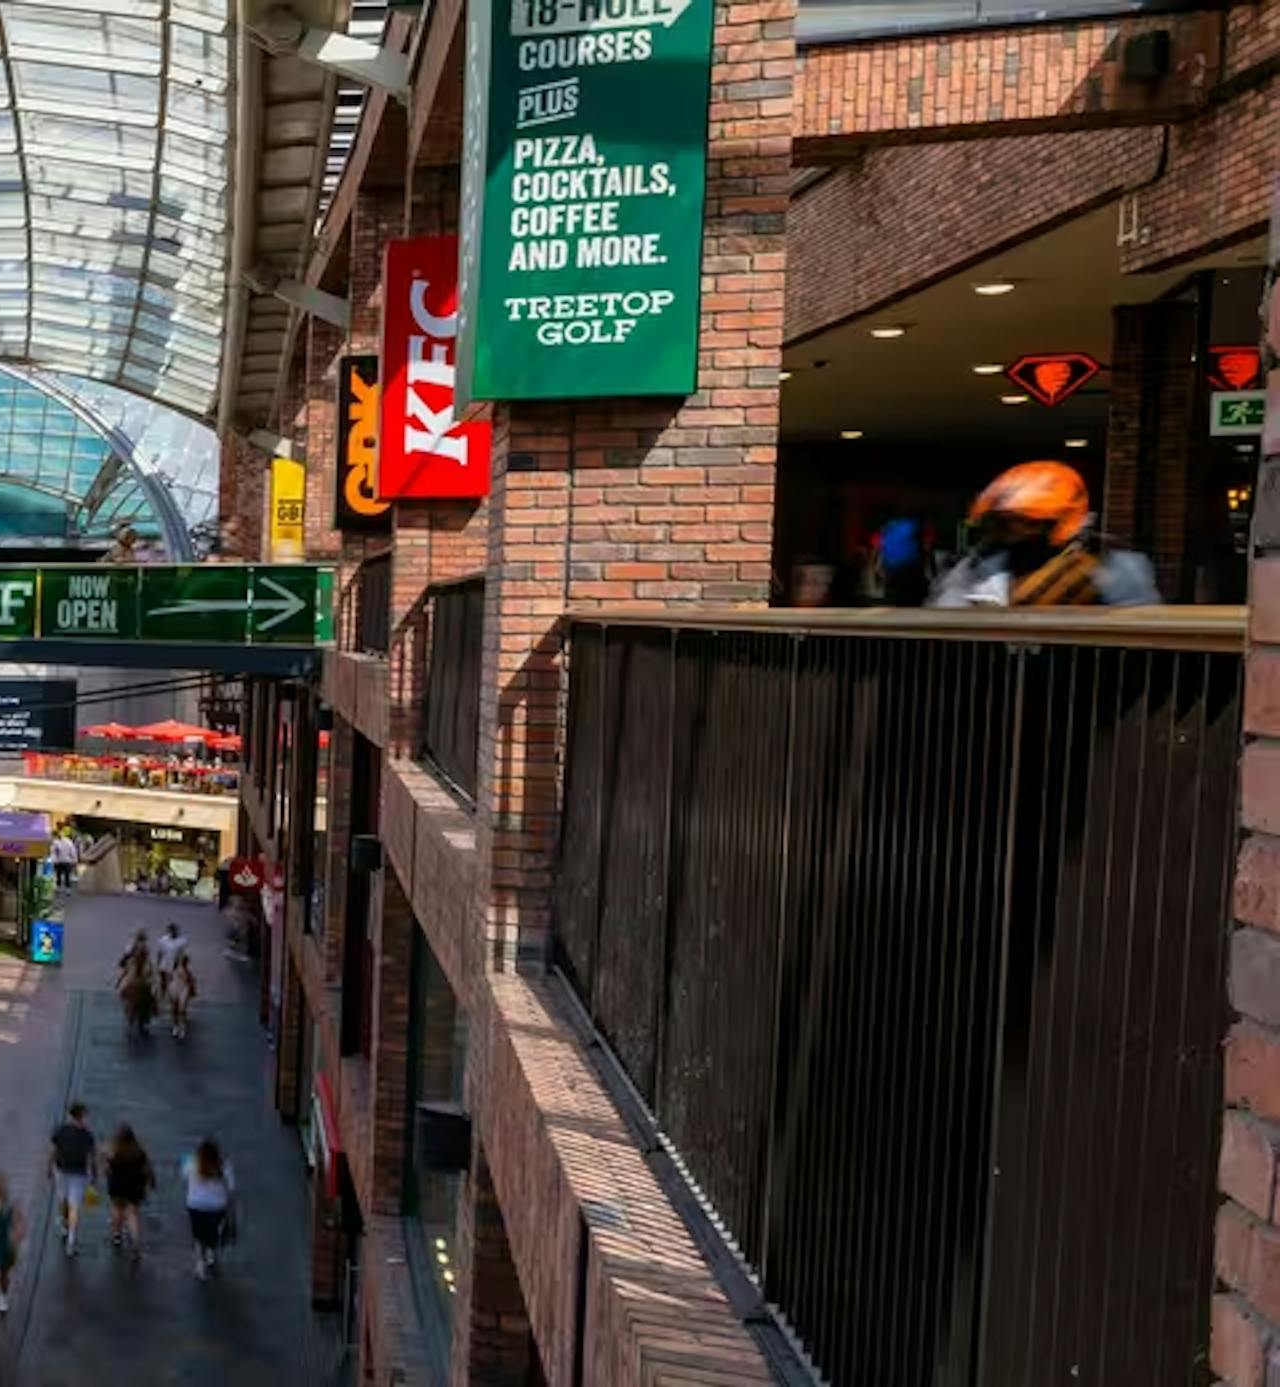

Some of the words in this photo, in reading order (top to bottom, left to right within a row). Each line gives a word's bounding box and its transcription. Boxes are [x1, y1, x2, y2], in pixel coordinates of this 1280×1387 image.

[518, 28, 653, 72] COURSES
[518, 84, 580, 121] PLUS
[513, 132, 605, 170] PIZZA,
[511, 162, 677, 204] COCKTAILS,
[510, 200, 620, 238] COFFEE
[508, 239, 568, 272] AND
[576, 233, 668, 269] MORE.
[504, 290, 675, 321] TREETOP
[536, 319, 636, 346] GOLF
[403, 279, 469, 467] KFC
[67, 575, 111, 598] NOW
[57, 599, 118, 629] OPEN
